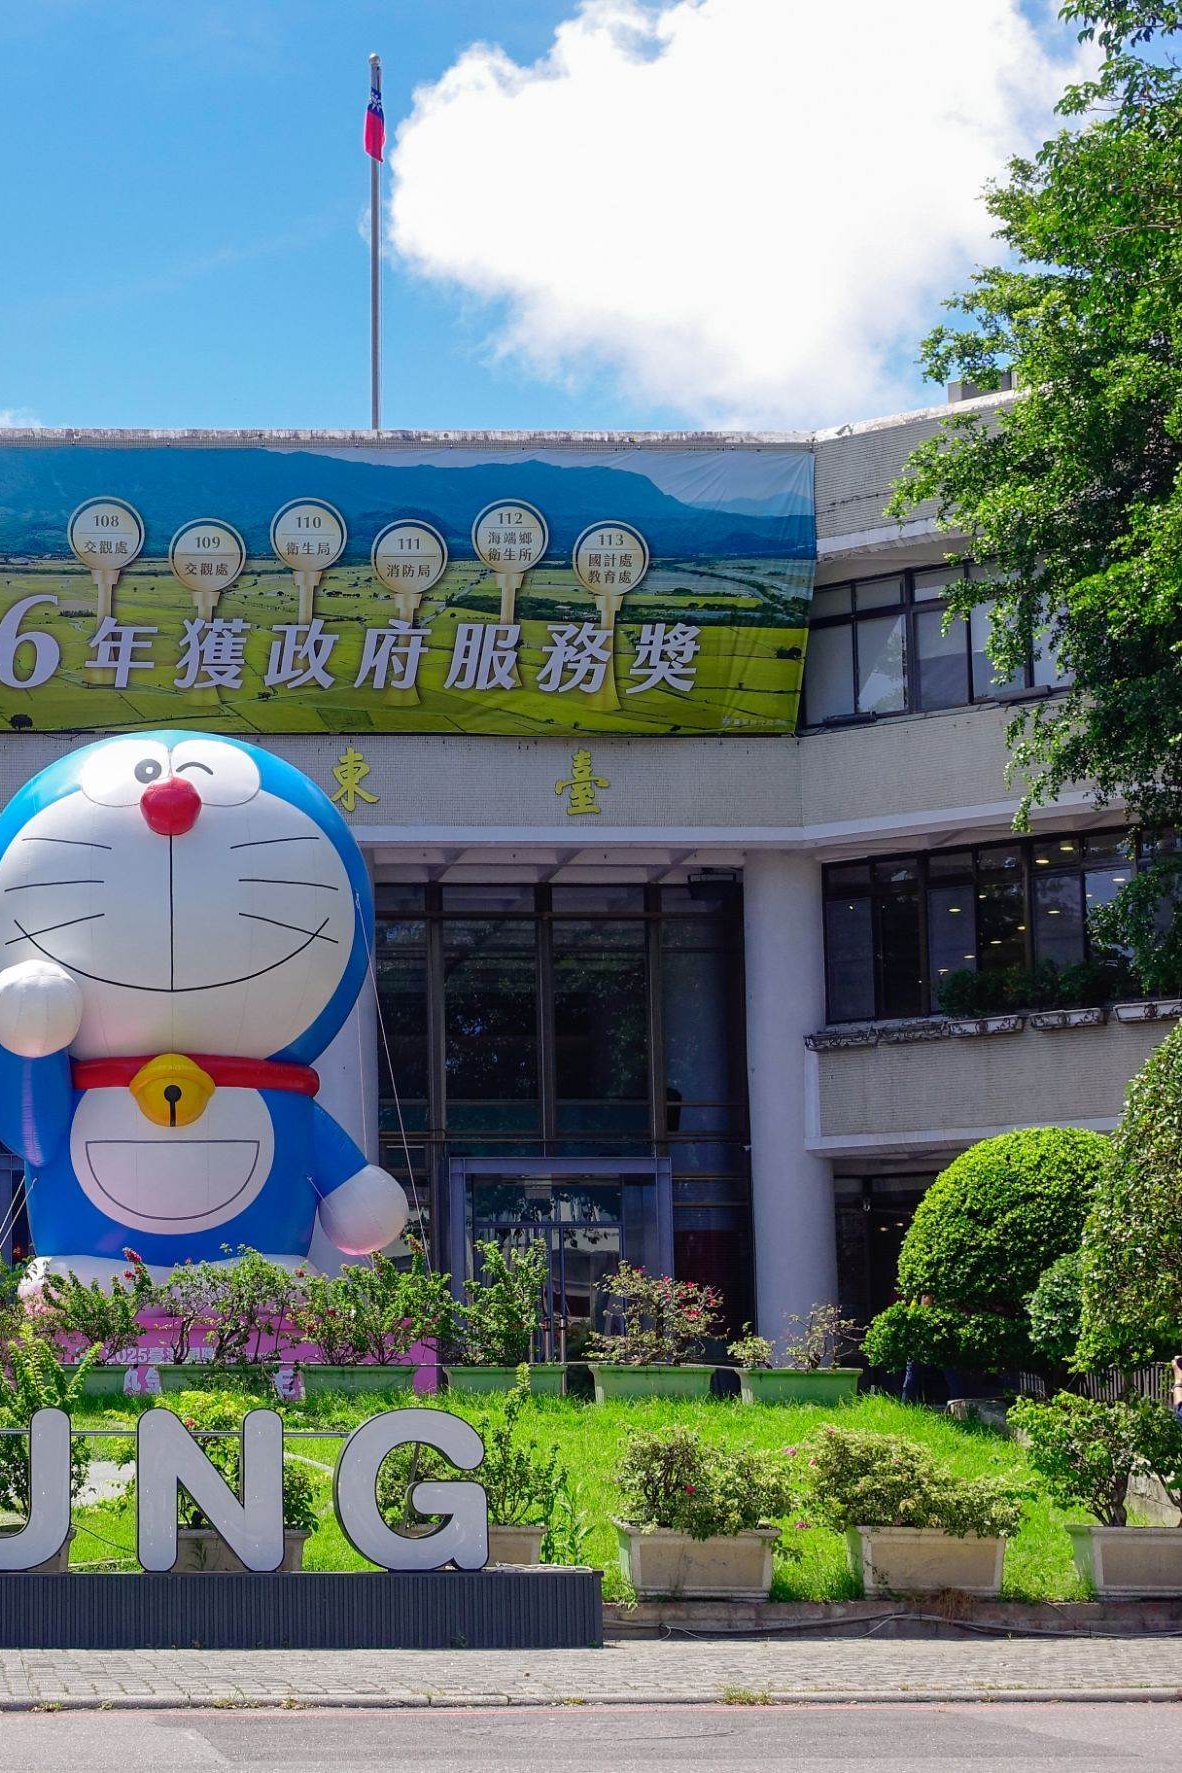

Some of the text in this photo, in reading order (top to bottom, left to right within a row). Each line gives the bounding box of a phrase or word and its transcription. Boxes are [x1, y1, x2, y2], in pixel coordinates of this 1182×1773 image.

[93, 514, 120, 528] 108
[295, 516, 322, 529] 110
[497, 511, 523, 525] 112
[194, 536, 221, 549] 109
[397, 537, 421, 550] 111
[487, 531, 533, 545] 海端鄉
[598, 533, 624, 546] 113
[83, 541, 129, 555] 交觀處
[285, 541, 331, 556] 衛生局
[487, 547, 533, 562] 衛生所
[588, 553, 633, 568] 國計處
[184, 562, 229, 577] 交觀處
[386, 563, 431, 578] 消防局
[587, 570, 633, 584] 教育處
